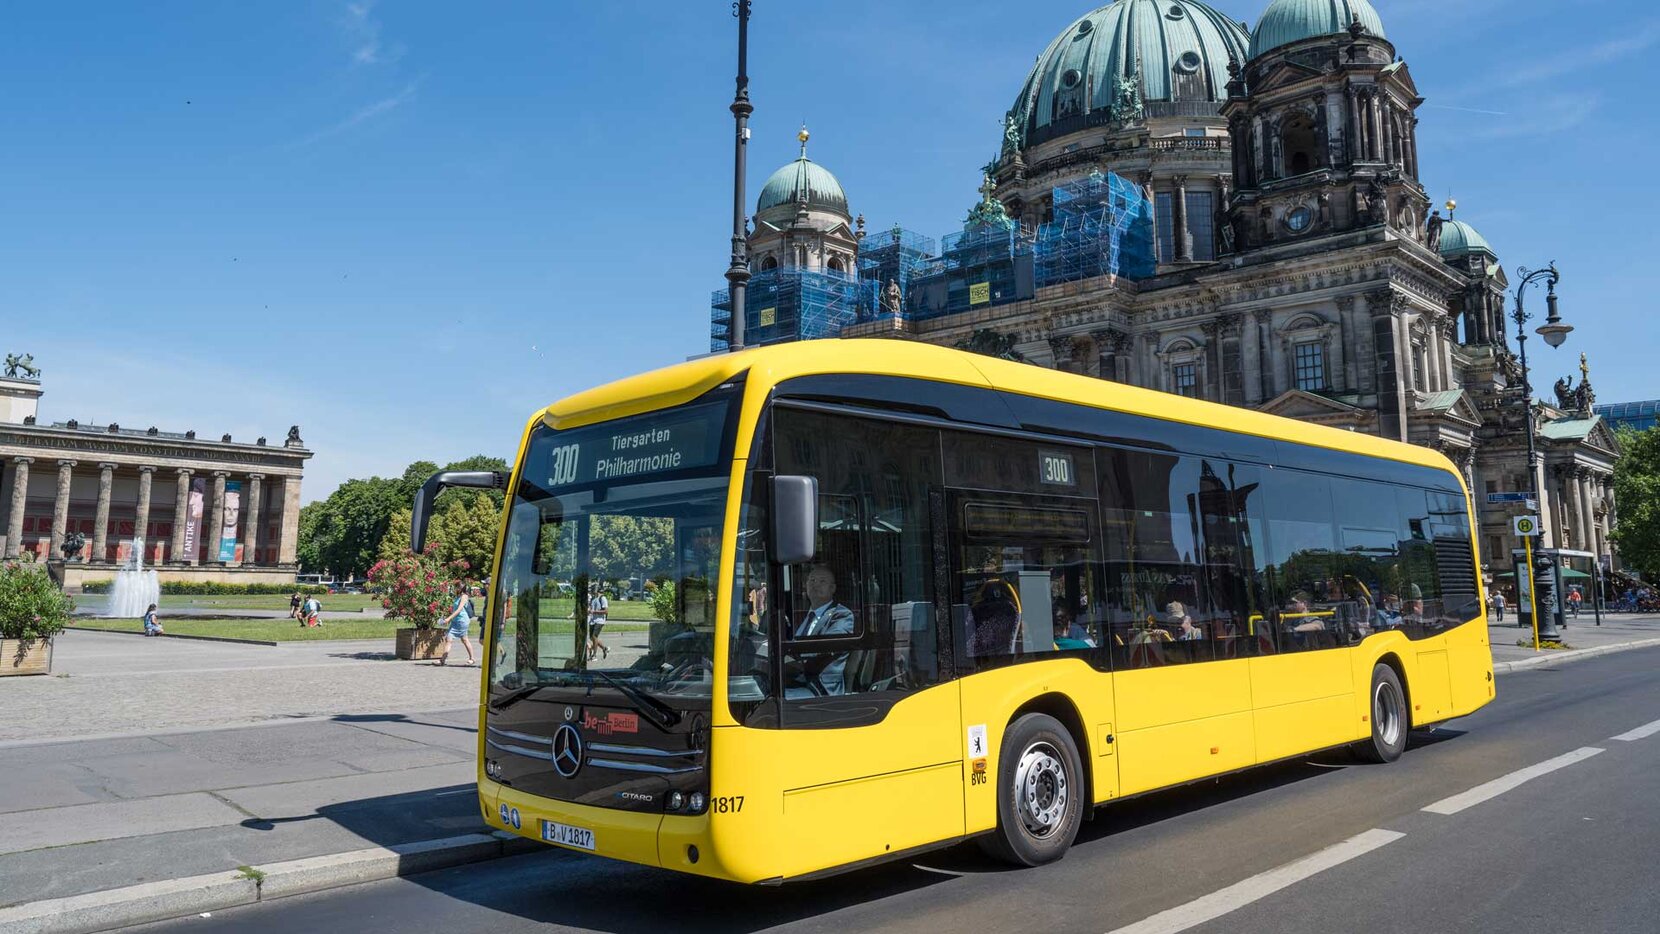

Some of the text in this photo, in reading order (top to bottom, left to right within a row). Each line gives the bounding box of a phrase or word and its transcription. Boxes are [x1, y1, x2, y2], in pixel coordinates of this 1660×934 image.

[612, 428, 671, 451] Tiergarten
[548, 443, 580, 486] 300
[595, 448, 682, 480] Philharmonie
[1044, 457, 1069, 482] 300
[184, 520, 195, 552] ANTIKE
[1521, 522, 1529, 530] H
[584, 710, 636, 729] be Berlin
[971, 772, 987, 786] BVG
[711, 795, 745, 814] 1817
[550, 824, 591, 847] B V 1817
